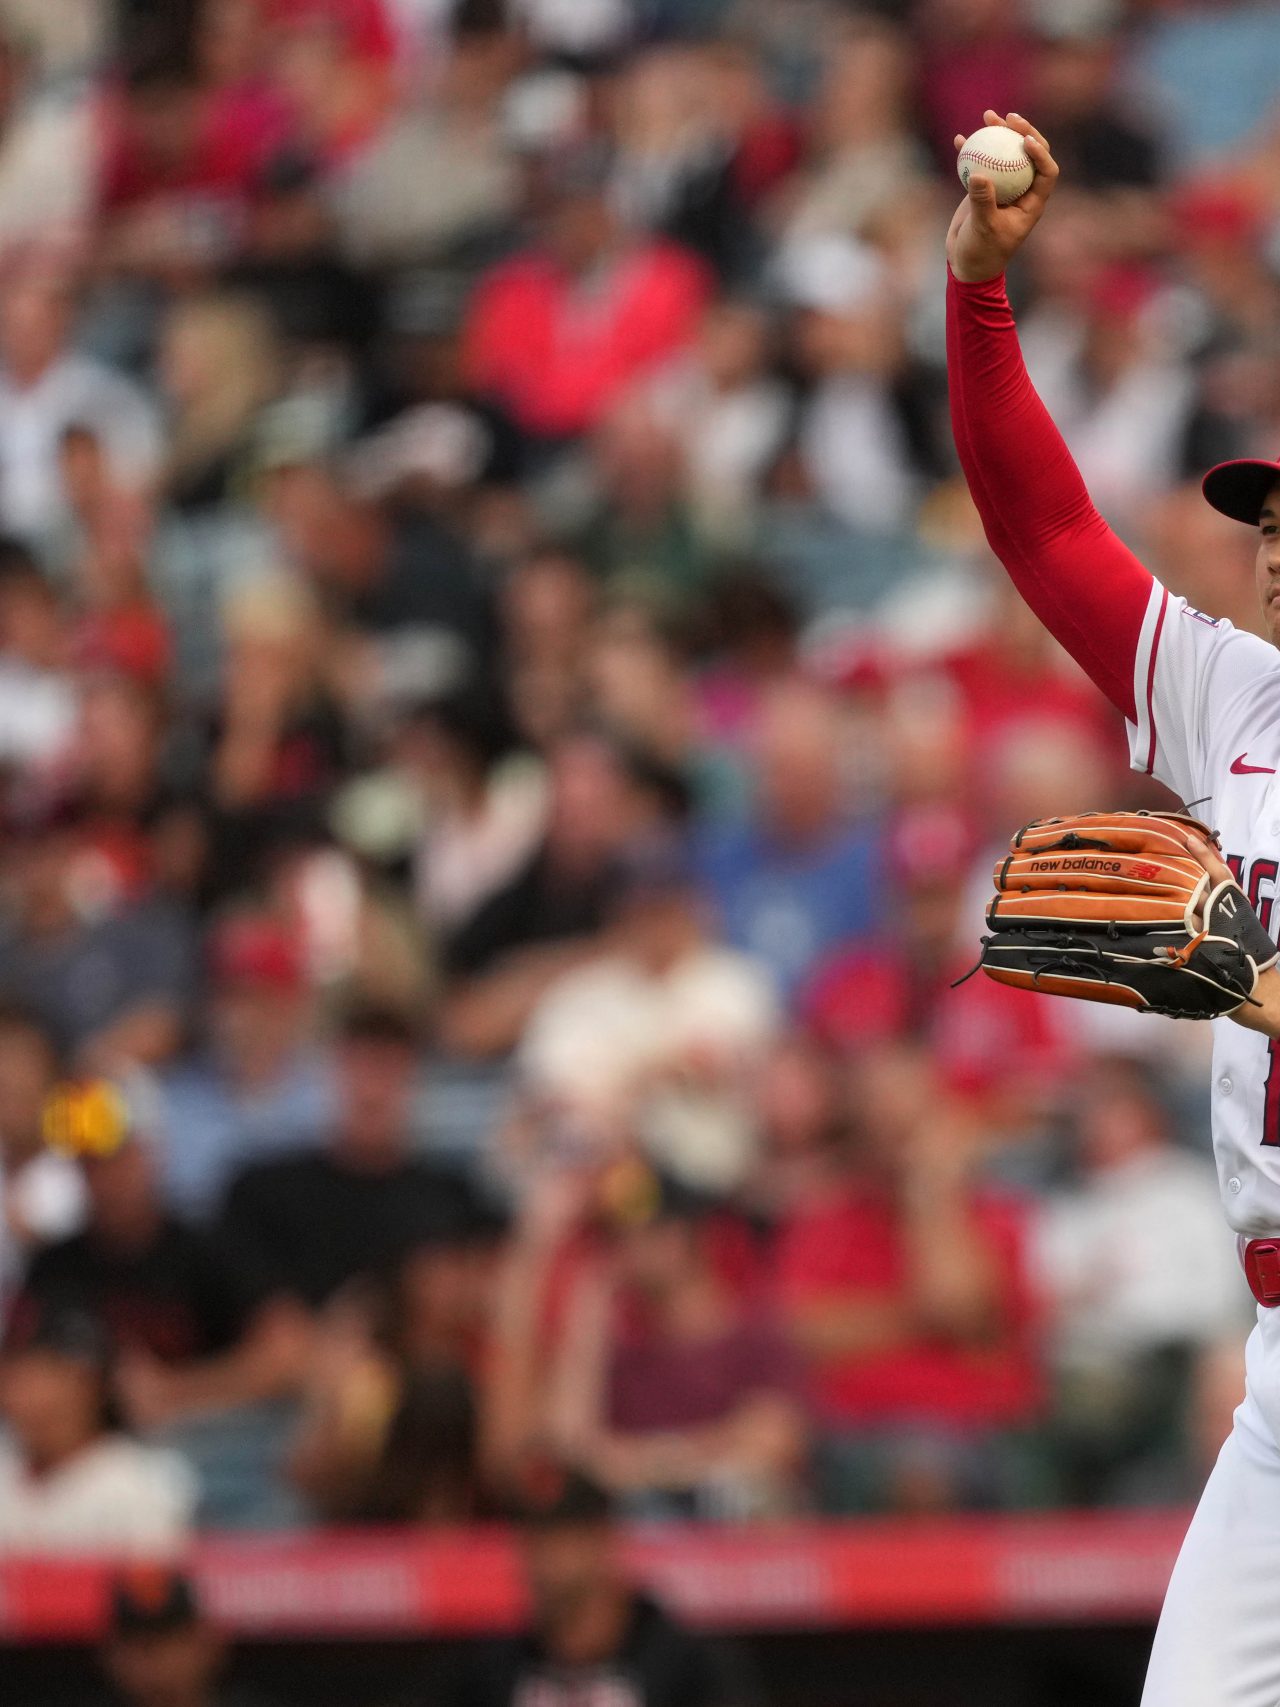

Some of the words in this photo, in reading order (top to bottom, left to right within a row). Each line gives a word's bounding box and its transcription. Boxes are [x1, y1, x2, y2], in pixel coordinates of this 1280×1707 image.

[1031, 859, 1060, 872] new
[1062, 857, 1121, 872] balance
[1218, 893, 1237, 918] 17
